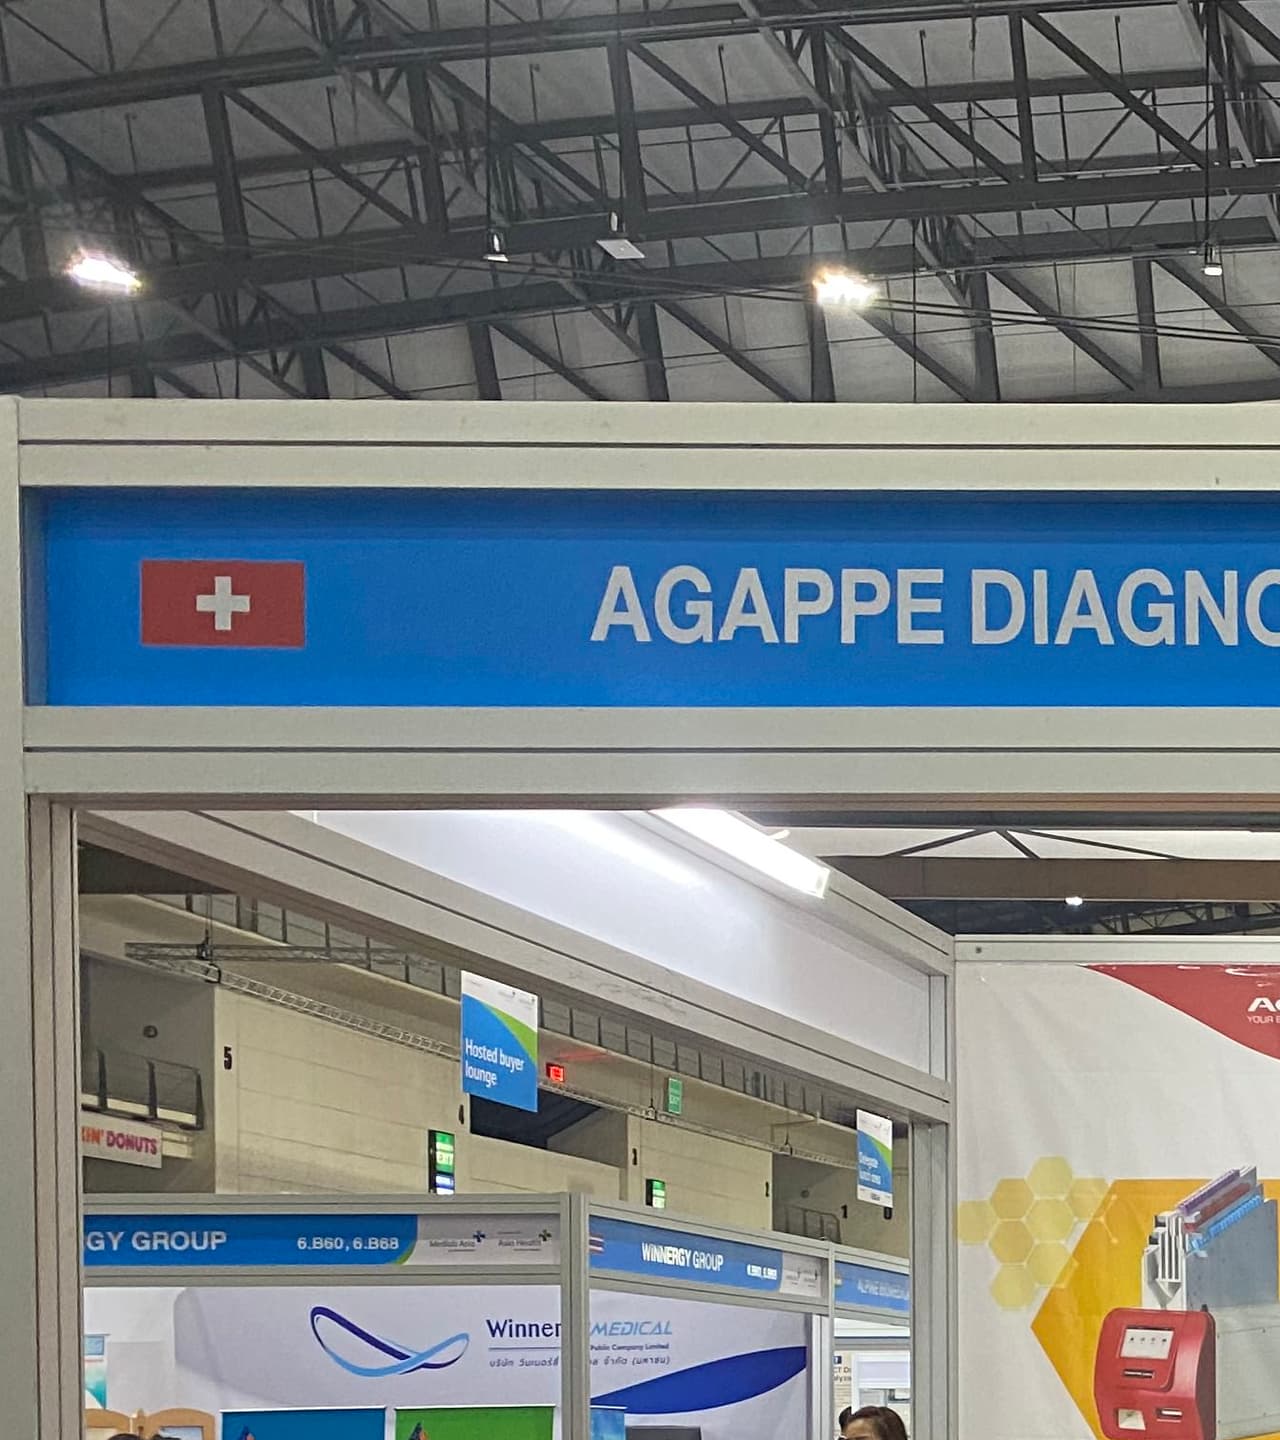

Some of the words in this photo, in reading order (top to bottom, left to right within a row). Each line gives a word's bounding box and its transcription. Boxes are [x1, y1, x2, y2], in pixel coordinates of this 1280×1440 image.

[591, 564, 944, 646] AGAPPE
[1247, 1016, 1274, 1024] YOUR
[223, 1046, 232, 1070] 5
[464, 1038, 498, 1065] Hosted
[499, 1051, 525, 1072] buyer
[464, 1060, 498, 1088] lounge
[106, 1130, 158, 1155] DONUTS
[85, 1230, 125, 1252] GY
[131, 1230, 227, 1252] GROUP
[297, 1237, 350, 1252] 6.B60,
[353, 1237, 400, 1250] 6.B68
[641, 1242, 692, 1268] WINNERGY
[692, 1251, 724, 1272] GROUP
[486, 1319, 562, 1338] Winner
